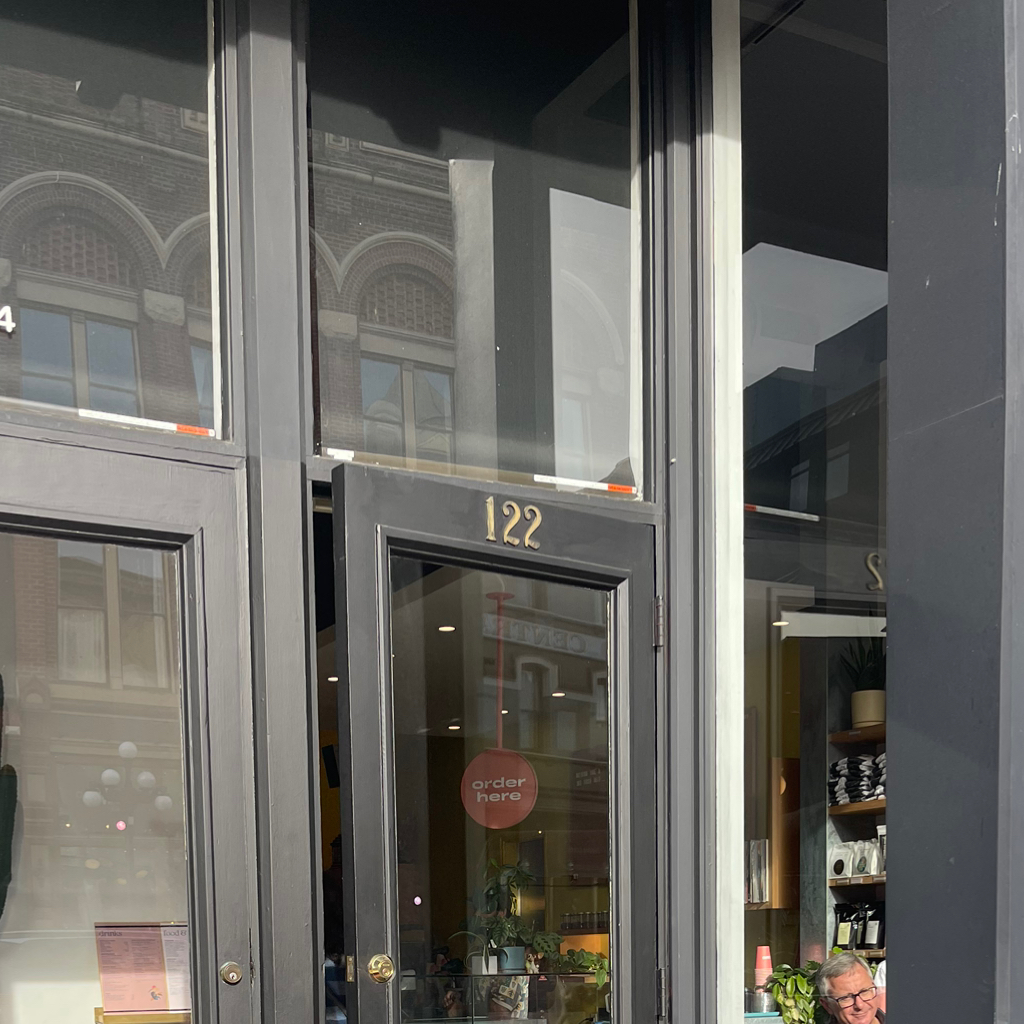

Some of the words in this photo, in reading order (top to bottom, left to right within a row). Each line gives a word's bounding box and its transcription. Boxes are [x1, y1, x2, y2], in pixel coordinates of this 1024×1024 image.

[486, 496, 543, 550] 122
[471, 776, 527, 790] order
[476, 791, 522, 803] here
[163, 929, 180, 937] food
